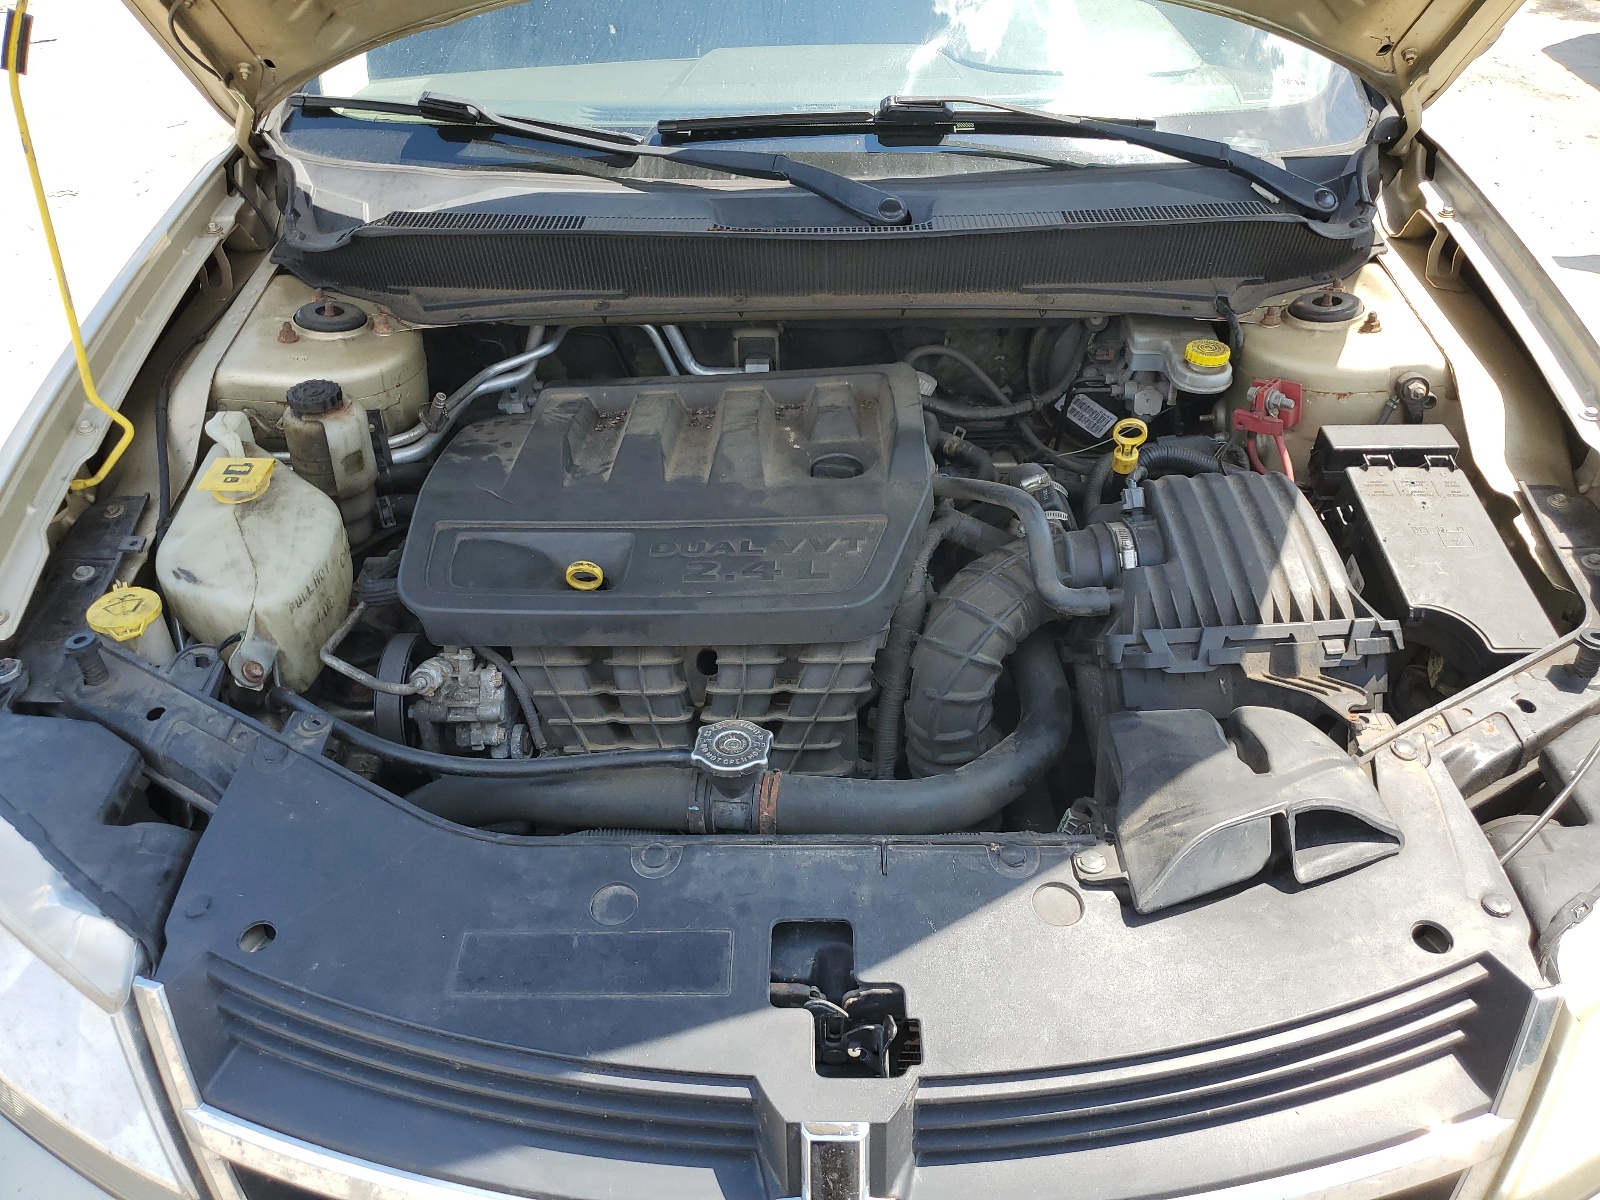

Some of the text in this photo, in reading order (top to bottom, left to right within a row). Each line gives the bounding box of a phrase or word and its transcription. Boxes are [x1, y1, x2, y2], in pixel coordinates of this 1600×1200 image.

[650, 537, 869, 557] DUAL VVT
[682, 560, 832, 582] 2.4 L
[288, 562, 330, 615] FULL HOT
